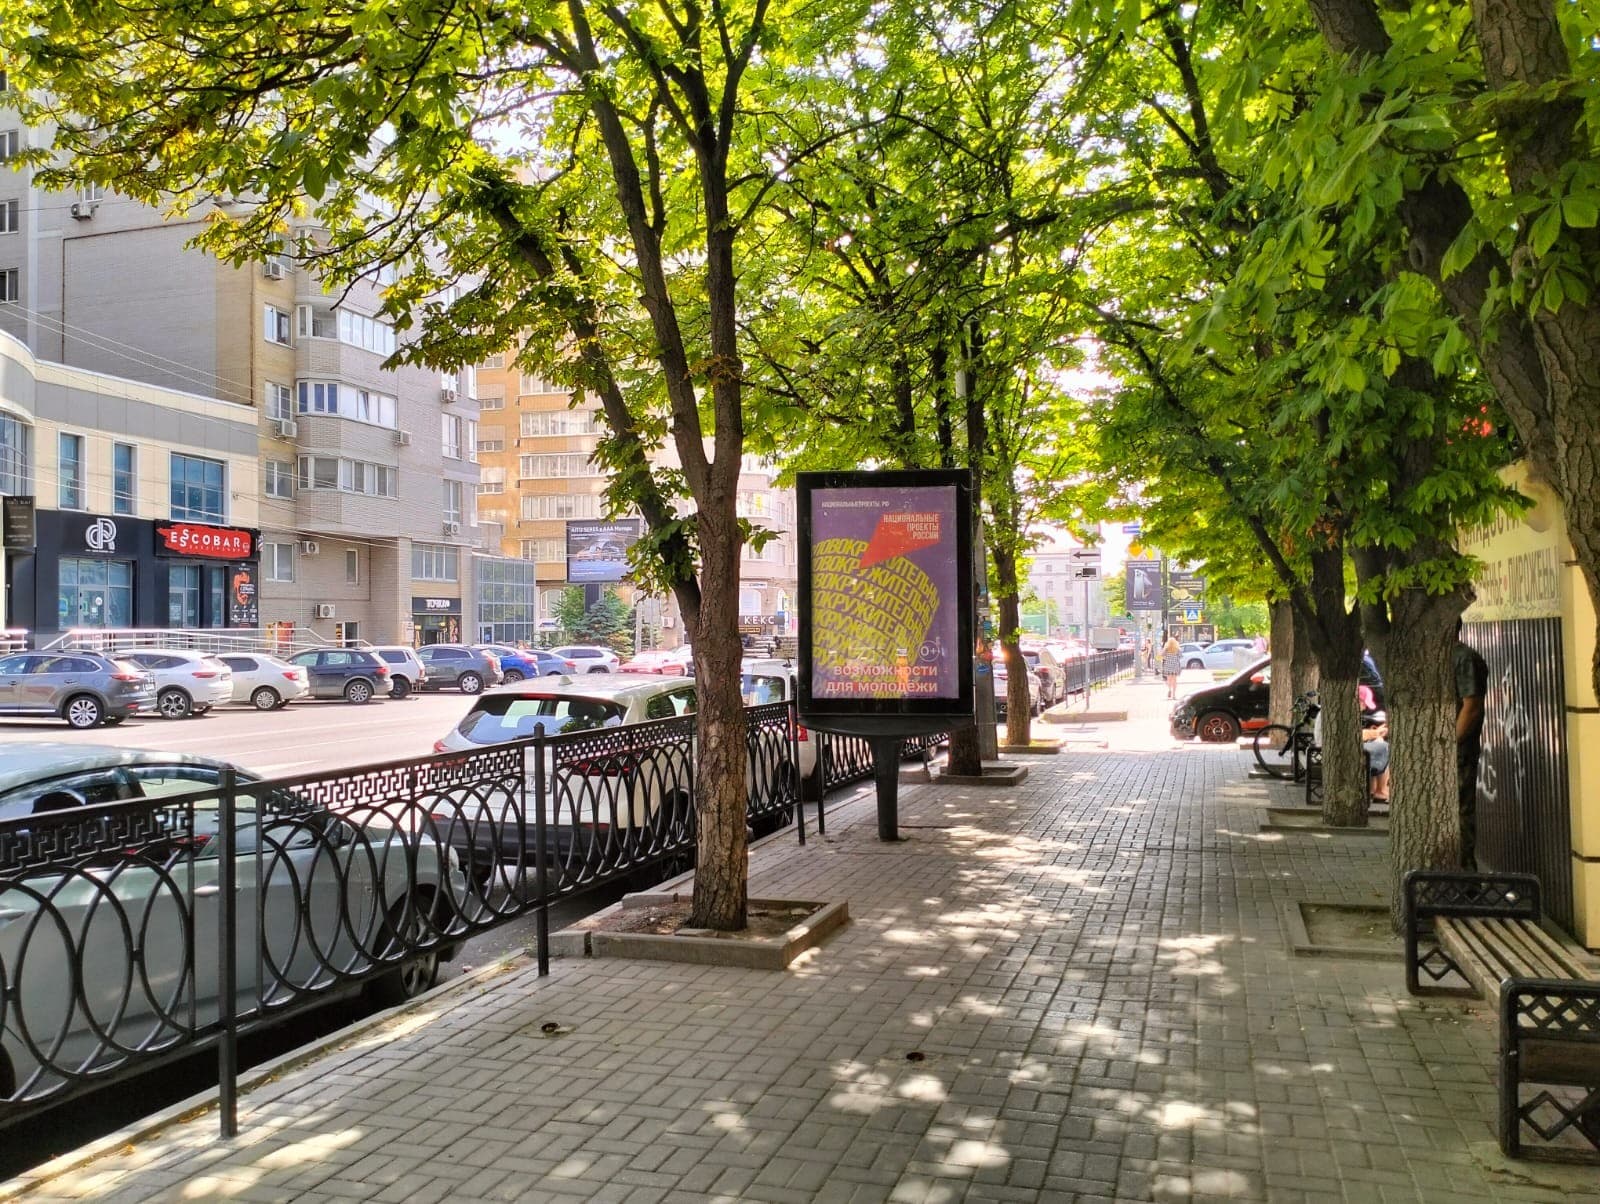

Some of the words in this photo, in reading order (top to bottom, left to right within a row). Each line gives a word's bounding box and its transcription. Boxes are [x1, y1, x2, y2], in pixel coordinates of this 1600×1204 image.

[883, 513, 939, 523] НАЦИОНАЛЬНЫЕ
[907, 523, 939, 532] ПРОЕКТЫ
[912, 532, 939, 541] РОССИИ
[833, 665, 938, 676] возможности
[825, 681, 854, 694] для
